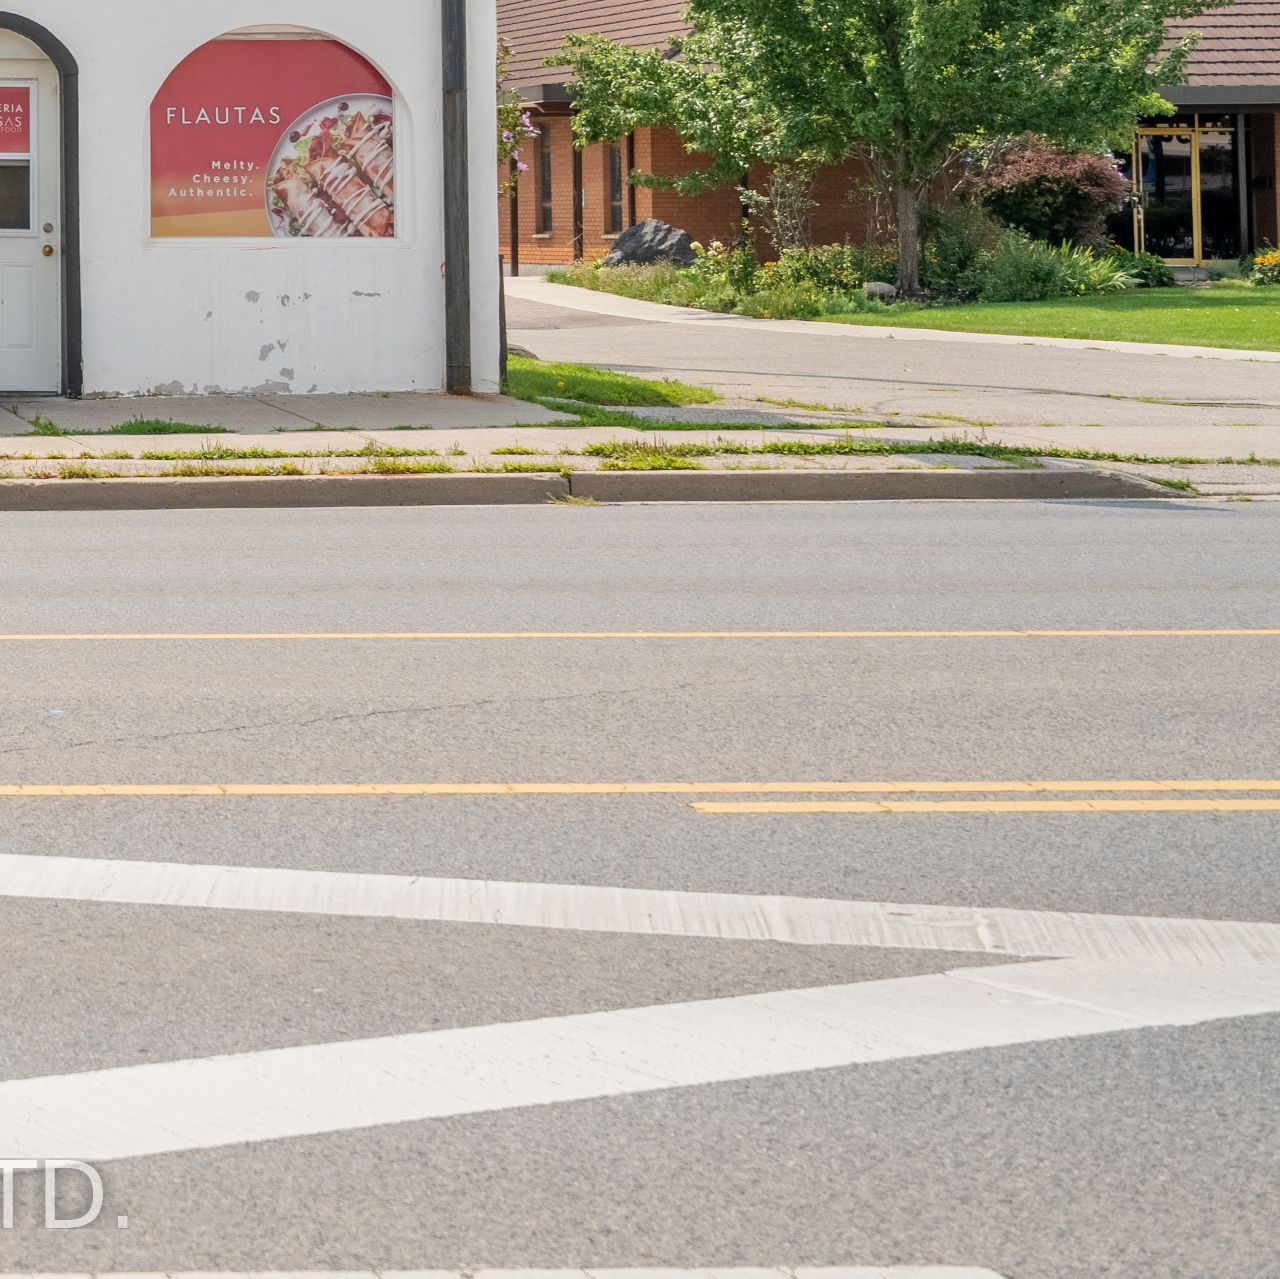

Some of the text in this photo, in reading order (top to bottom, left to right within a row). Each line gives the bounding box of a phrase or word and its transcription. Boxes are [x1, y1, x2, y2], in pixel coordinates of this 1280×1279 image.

[166, 106, 281, 126] FLAUTAS
[211, 159, 259, 171] Melty.
[192, 174, 253, 185] Cheesy.
[168, 187, 253, 198] Authentic.
